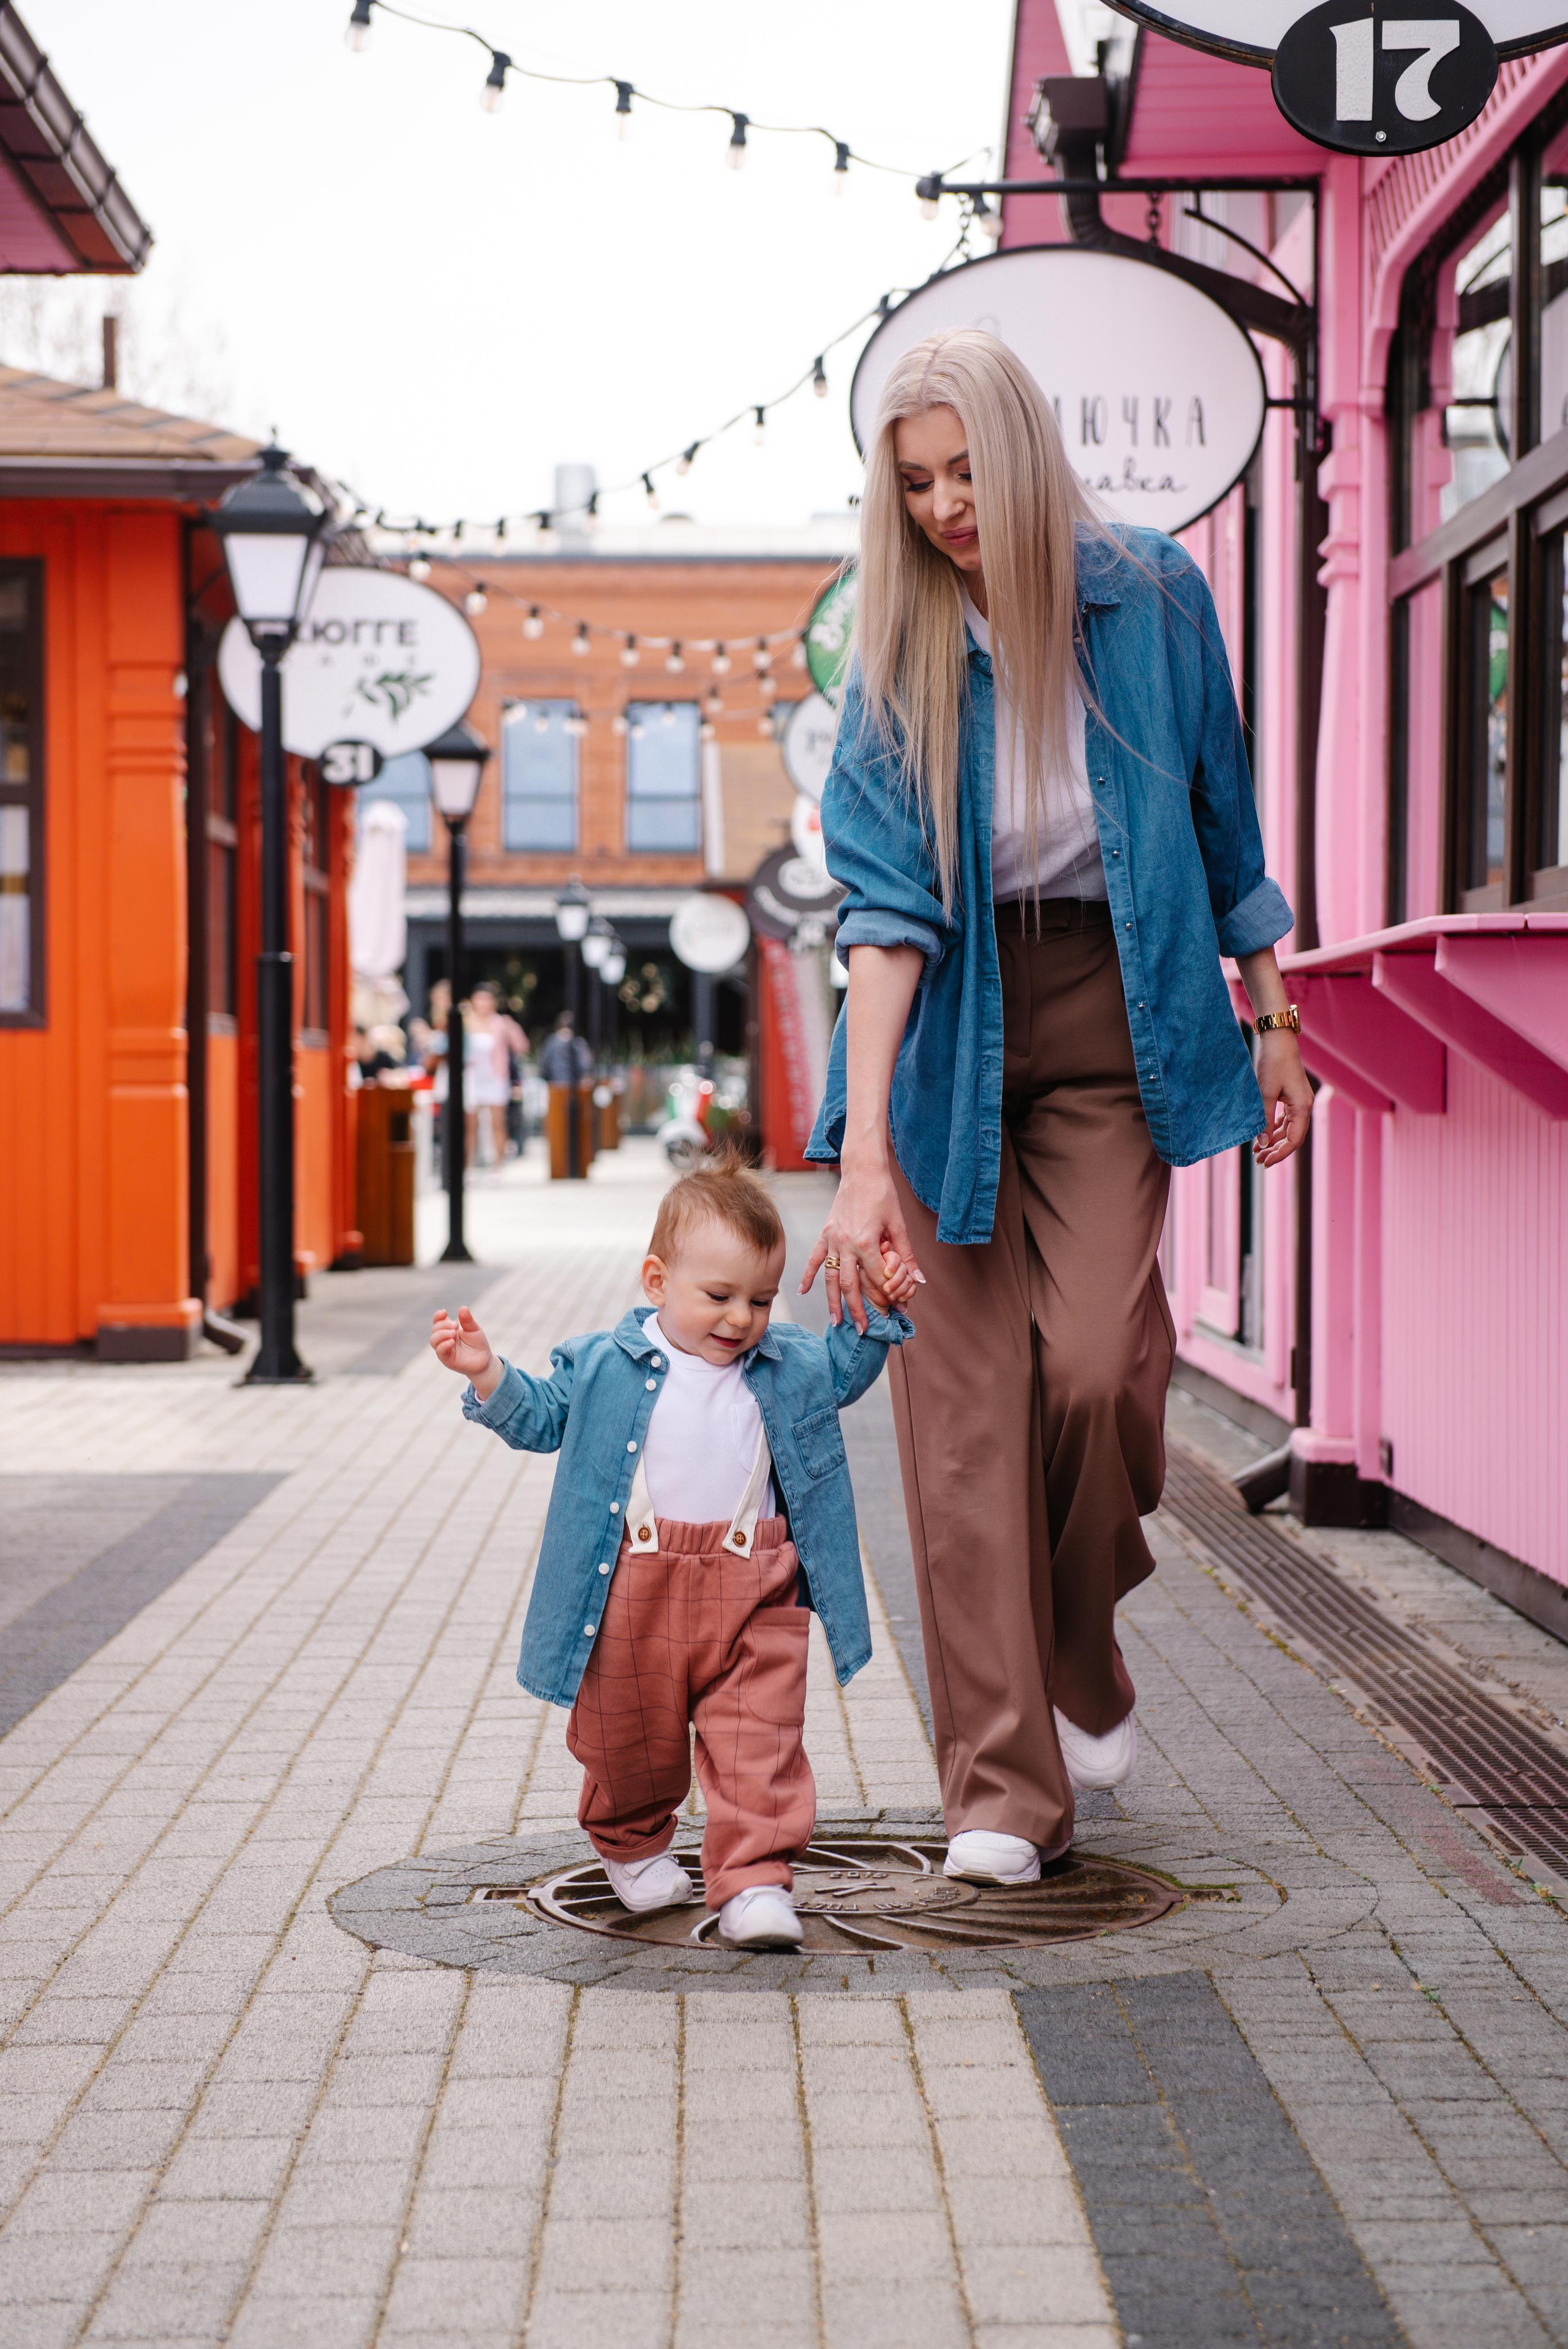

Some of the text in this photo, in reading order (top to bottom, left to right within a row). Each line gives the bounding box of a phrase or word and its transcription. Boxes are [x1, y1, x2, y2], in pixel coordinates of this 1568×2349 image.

[1329, 17, 1460, 121] 17
[299, 617, 419, 645] ЮГГЕ
[322, 743, 375, 783] 31
